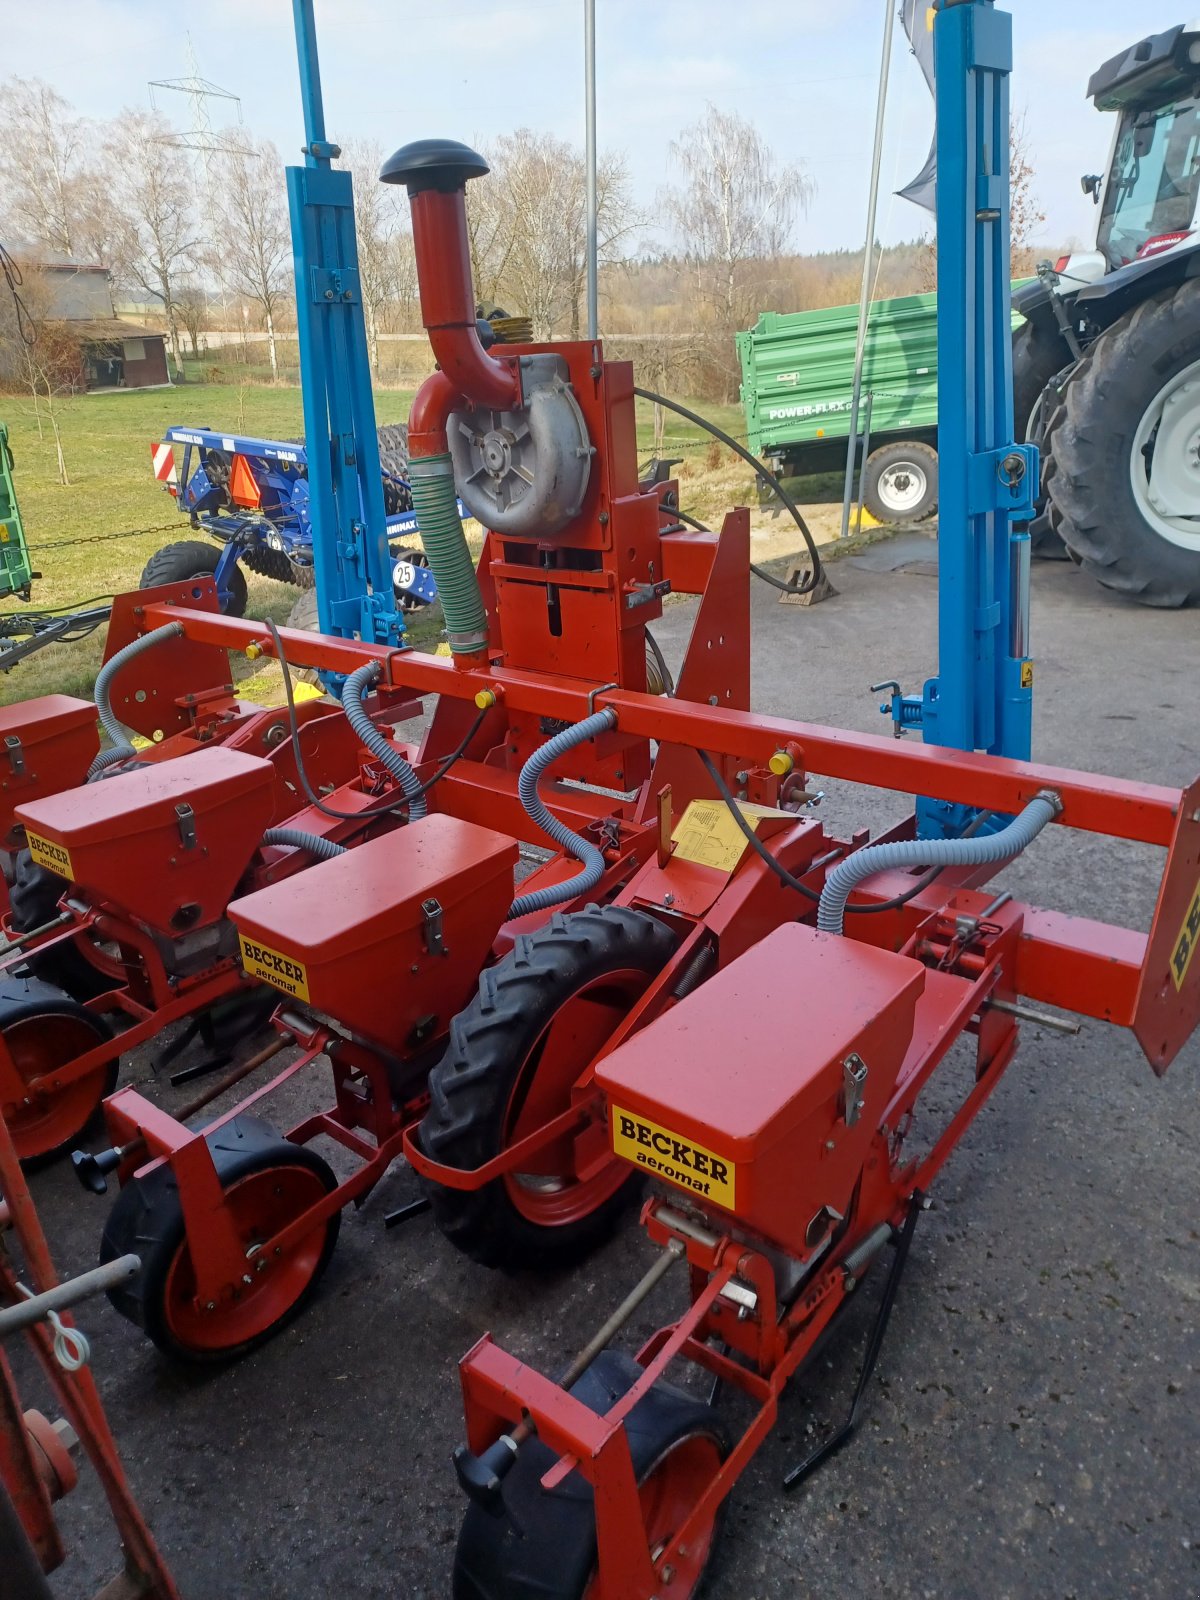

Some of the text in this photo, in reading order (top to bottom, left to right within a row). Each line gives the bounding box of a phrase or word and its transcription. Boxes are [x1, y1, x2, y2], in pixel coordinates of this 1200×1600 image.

[397, 566, 411, 584] 25
[29, 835, 70, 866] BECKER
[39, 857, 66, 876] aeromat
[243, 940, 305, 984] BECKER
[255, 968, 297, 994] aeromat
[619, 1115, 728, 1185] BECKER
[636, 1151, 711, 1195] aeromat
